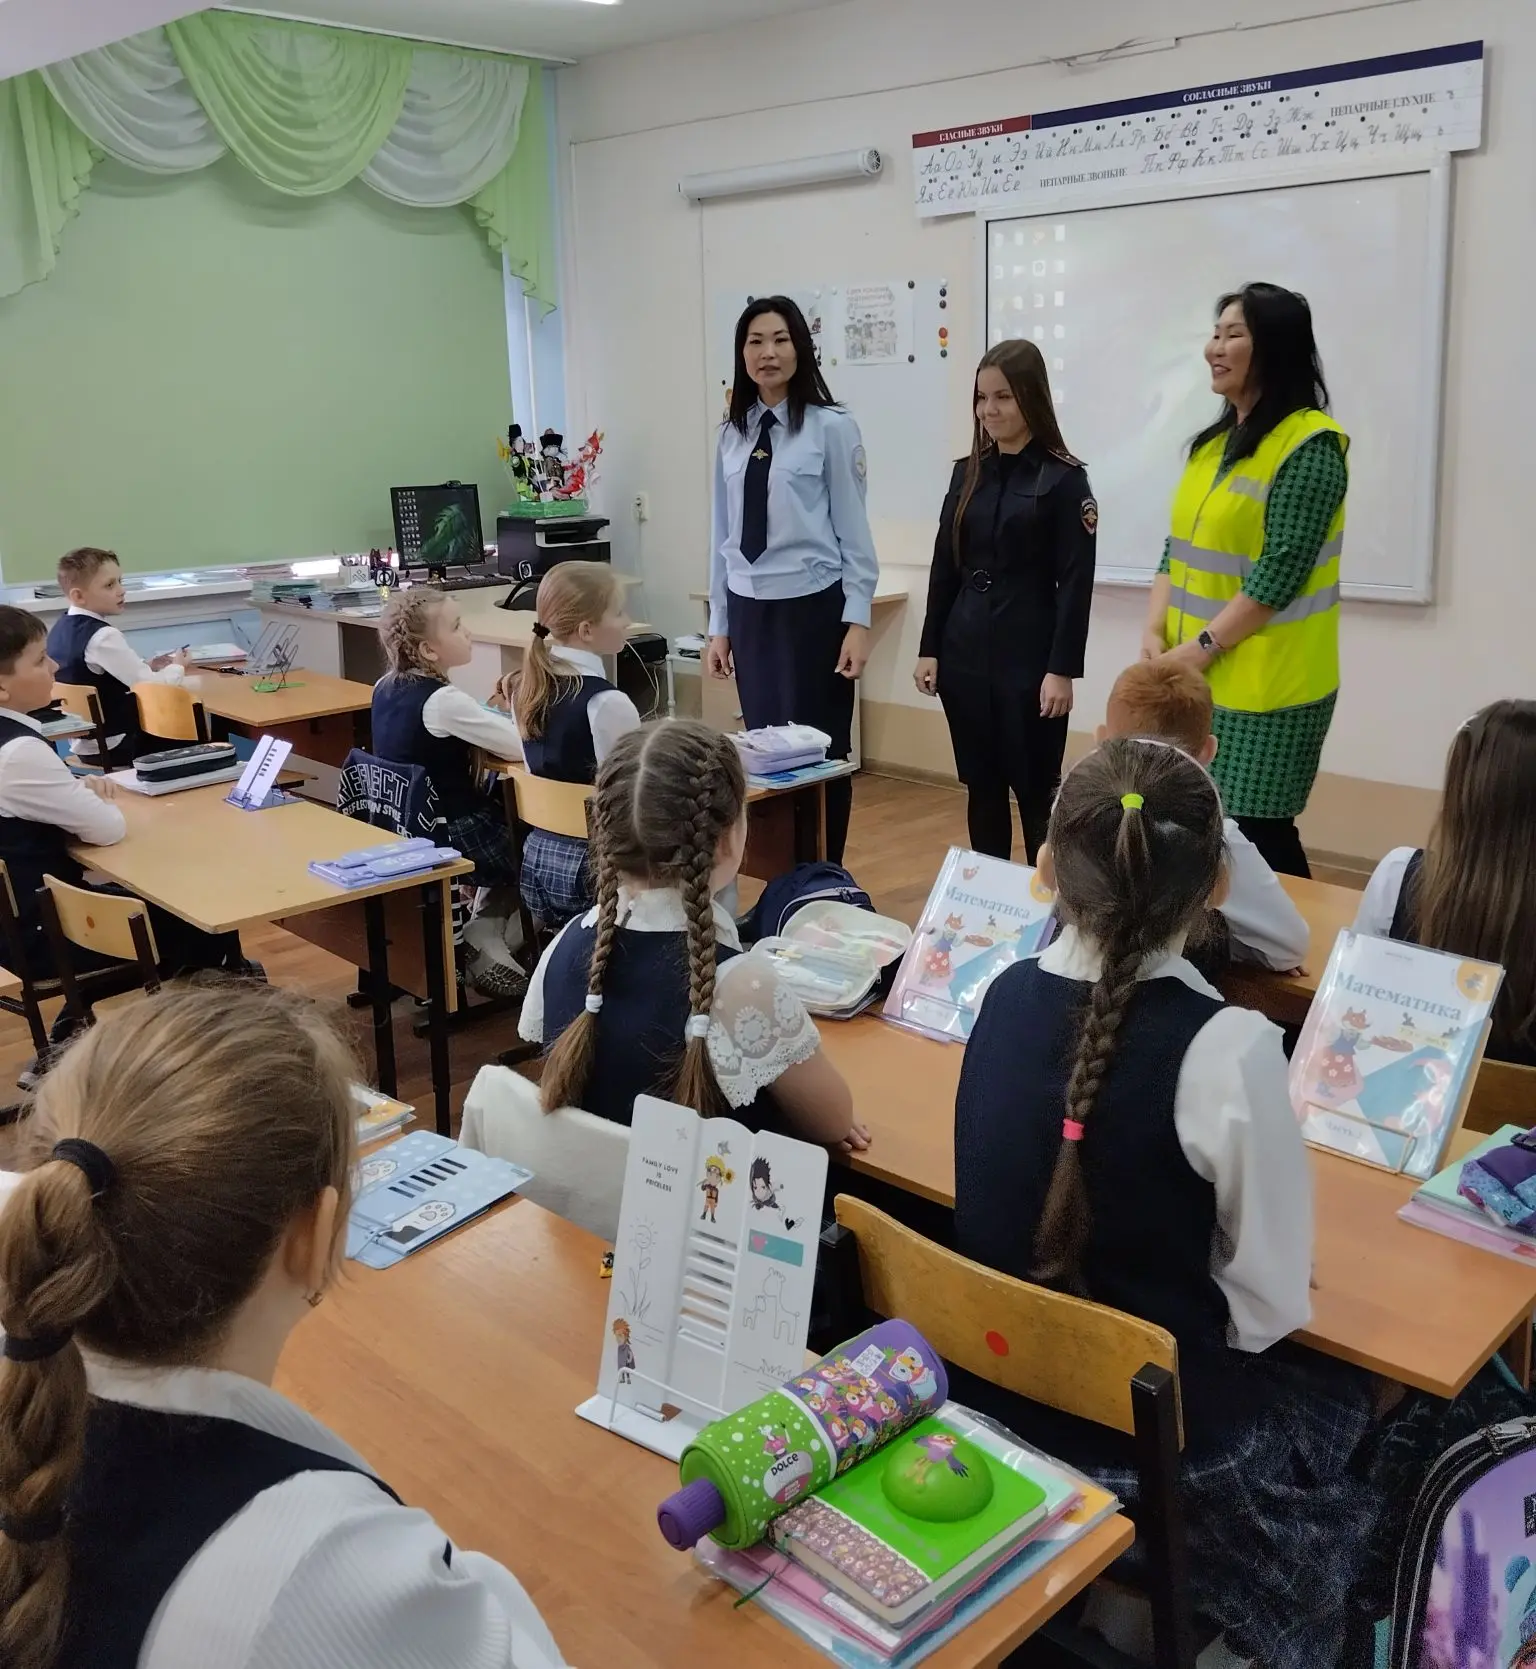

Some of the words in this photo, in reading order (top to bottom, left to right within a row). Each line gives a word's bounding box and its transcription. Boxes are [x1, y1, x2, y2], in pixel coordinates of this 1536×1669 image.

[1182, 85, 1239, 103] СОГЛАСНЫЕ
[1239, 80, 1272, 95] ЗВУКИ
[1330, 98, 1389, 117] НЕПАРНЫЕ
[1392, 92, 1437, 109] ГЛУХИЕ
[939, 127, 976, 142] ГЛАСНЫЕ
[976, 123, 1003, 135] ЗВУКИ
[1039, 171, 1086, 188] НЕПАРНЫЕ
[1086, 166, 1128, 183] ЗВОНКИЕ
[1336, 971, 1463, 1021] Математика
